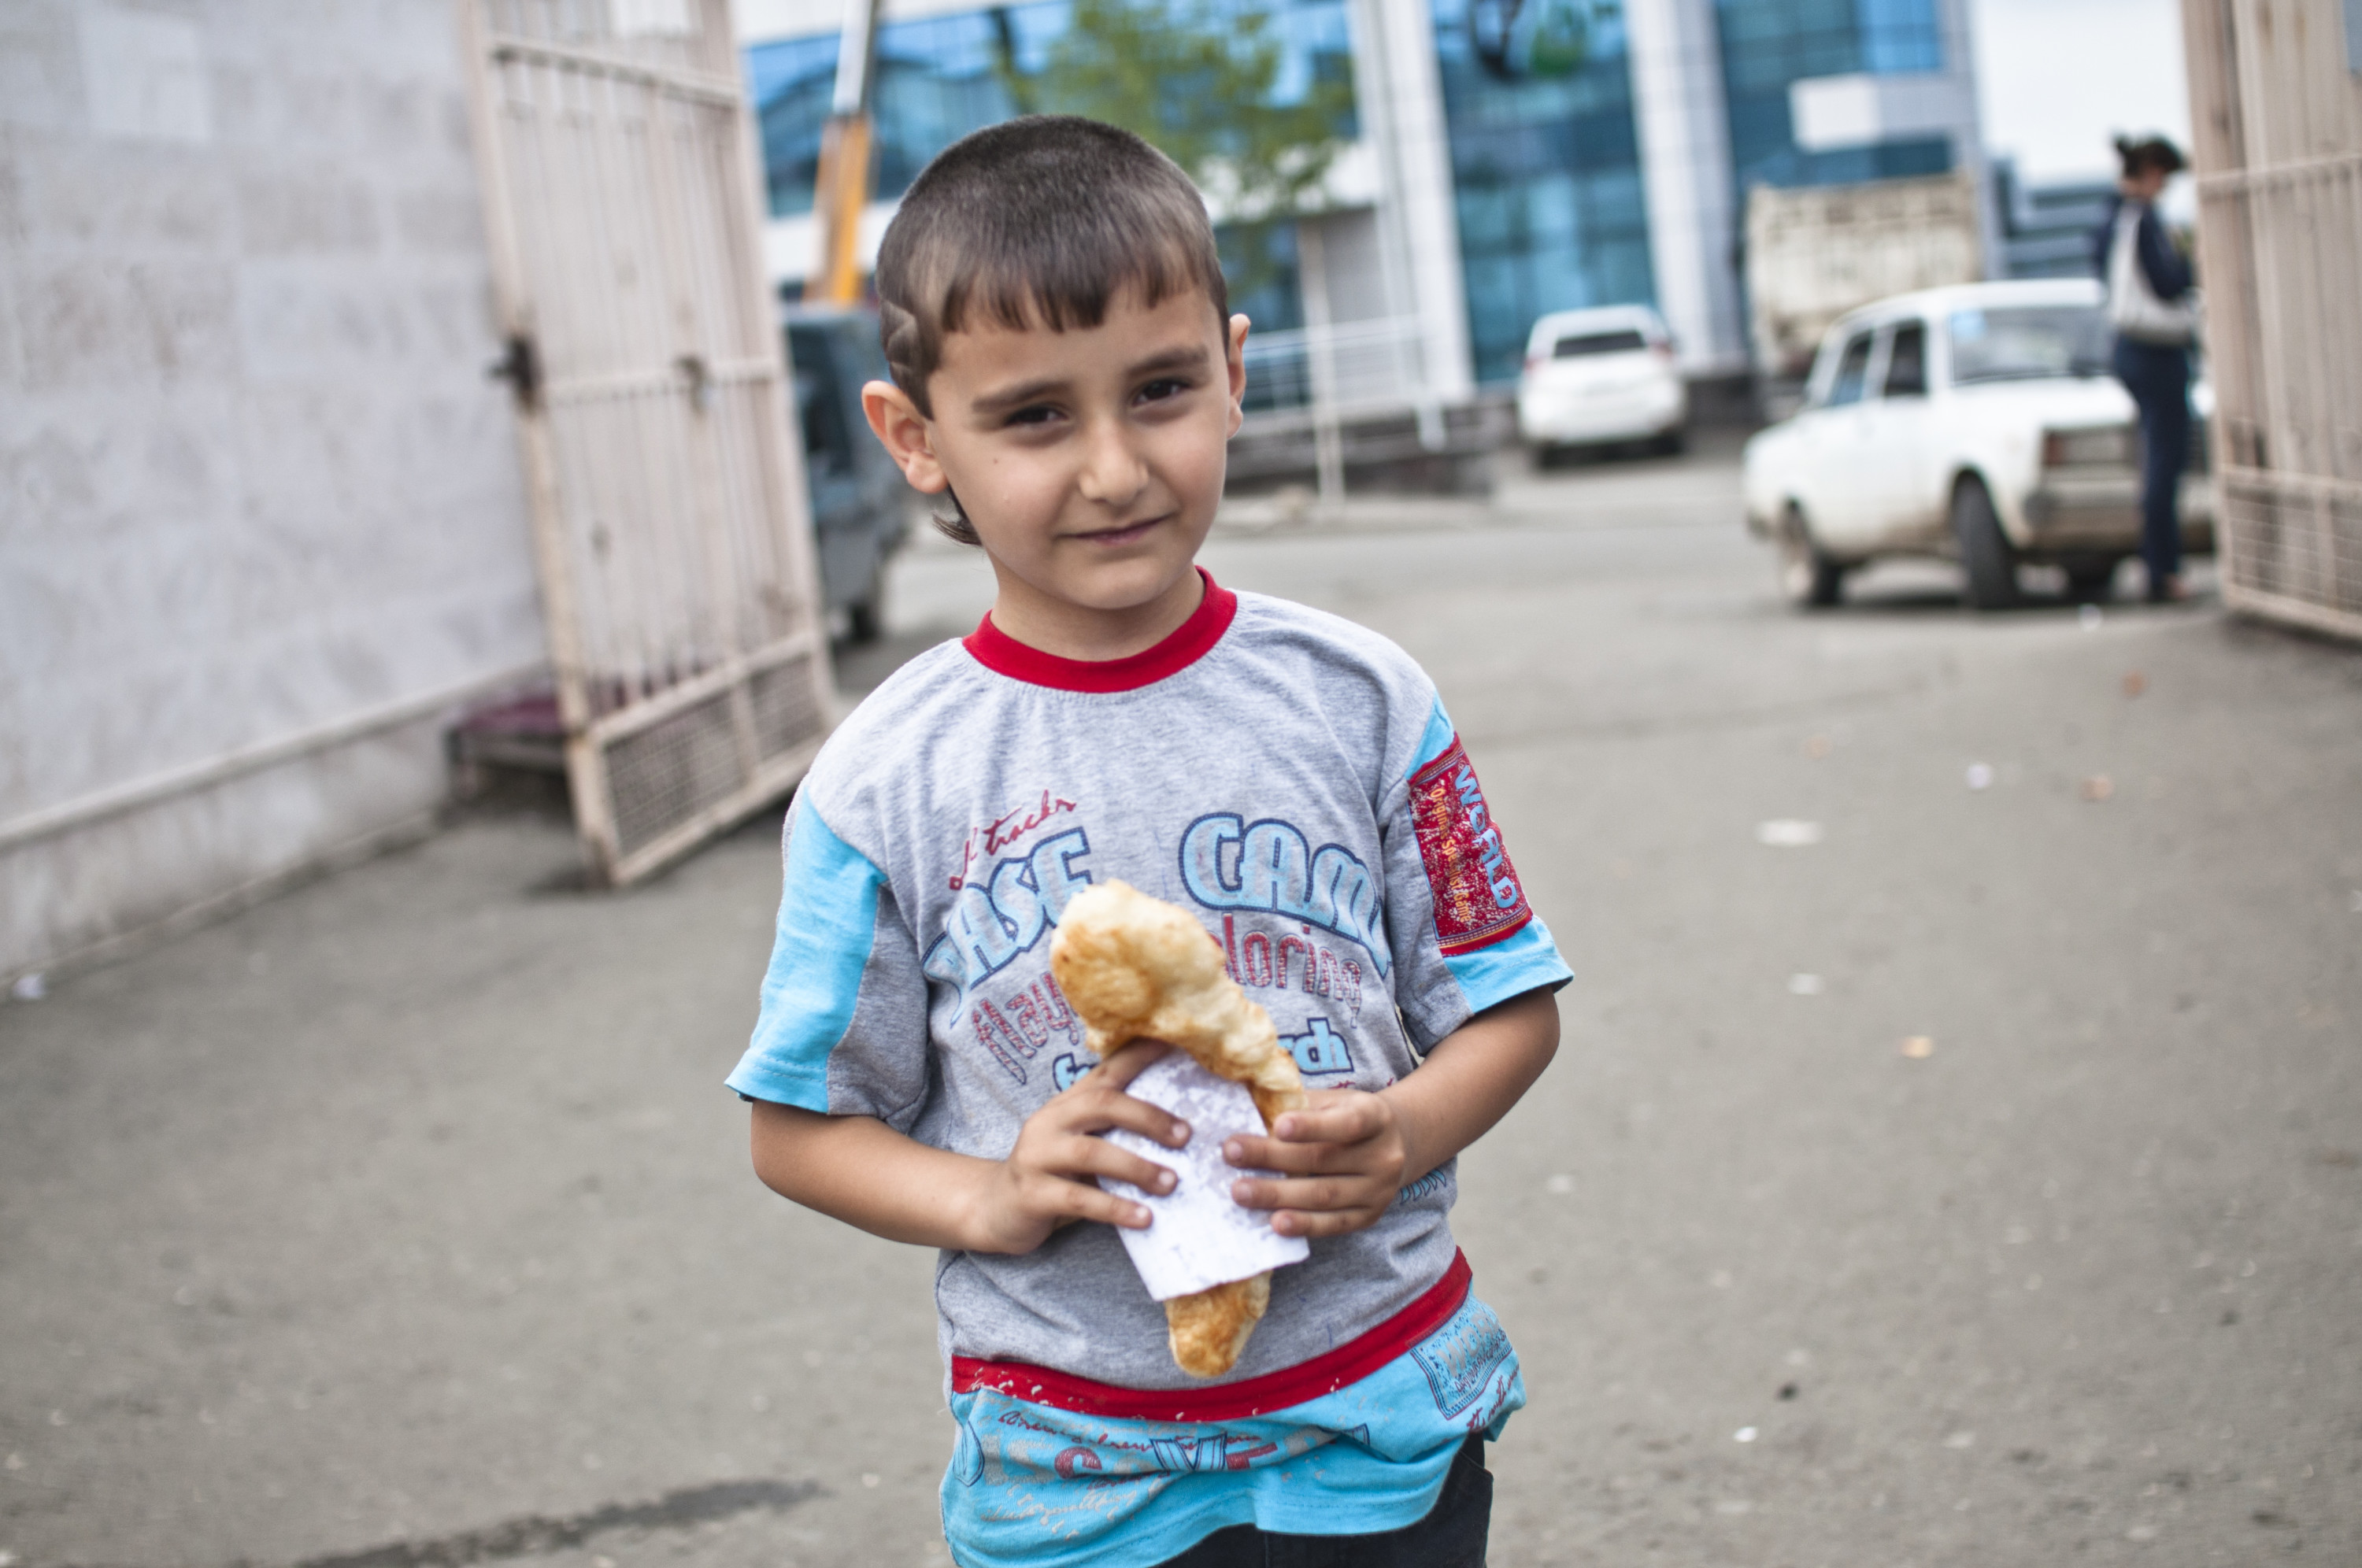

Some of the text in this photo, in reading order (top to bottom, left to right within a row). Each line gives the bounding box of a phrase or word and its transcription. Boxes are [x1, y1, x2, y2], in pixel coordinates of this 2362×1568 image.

[1178, 812, 1393, 979] CAM
[1453, 891, 1472, 924] Game
[1455, 765, 1517, 908] WORLD
